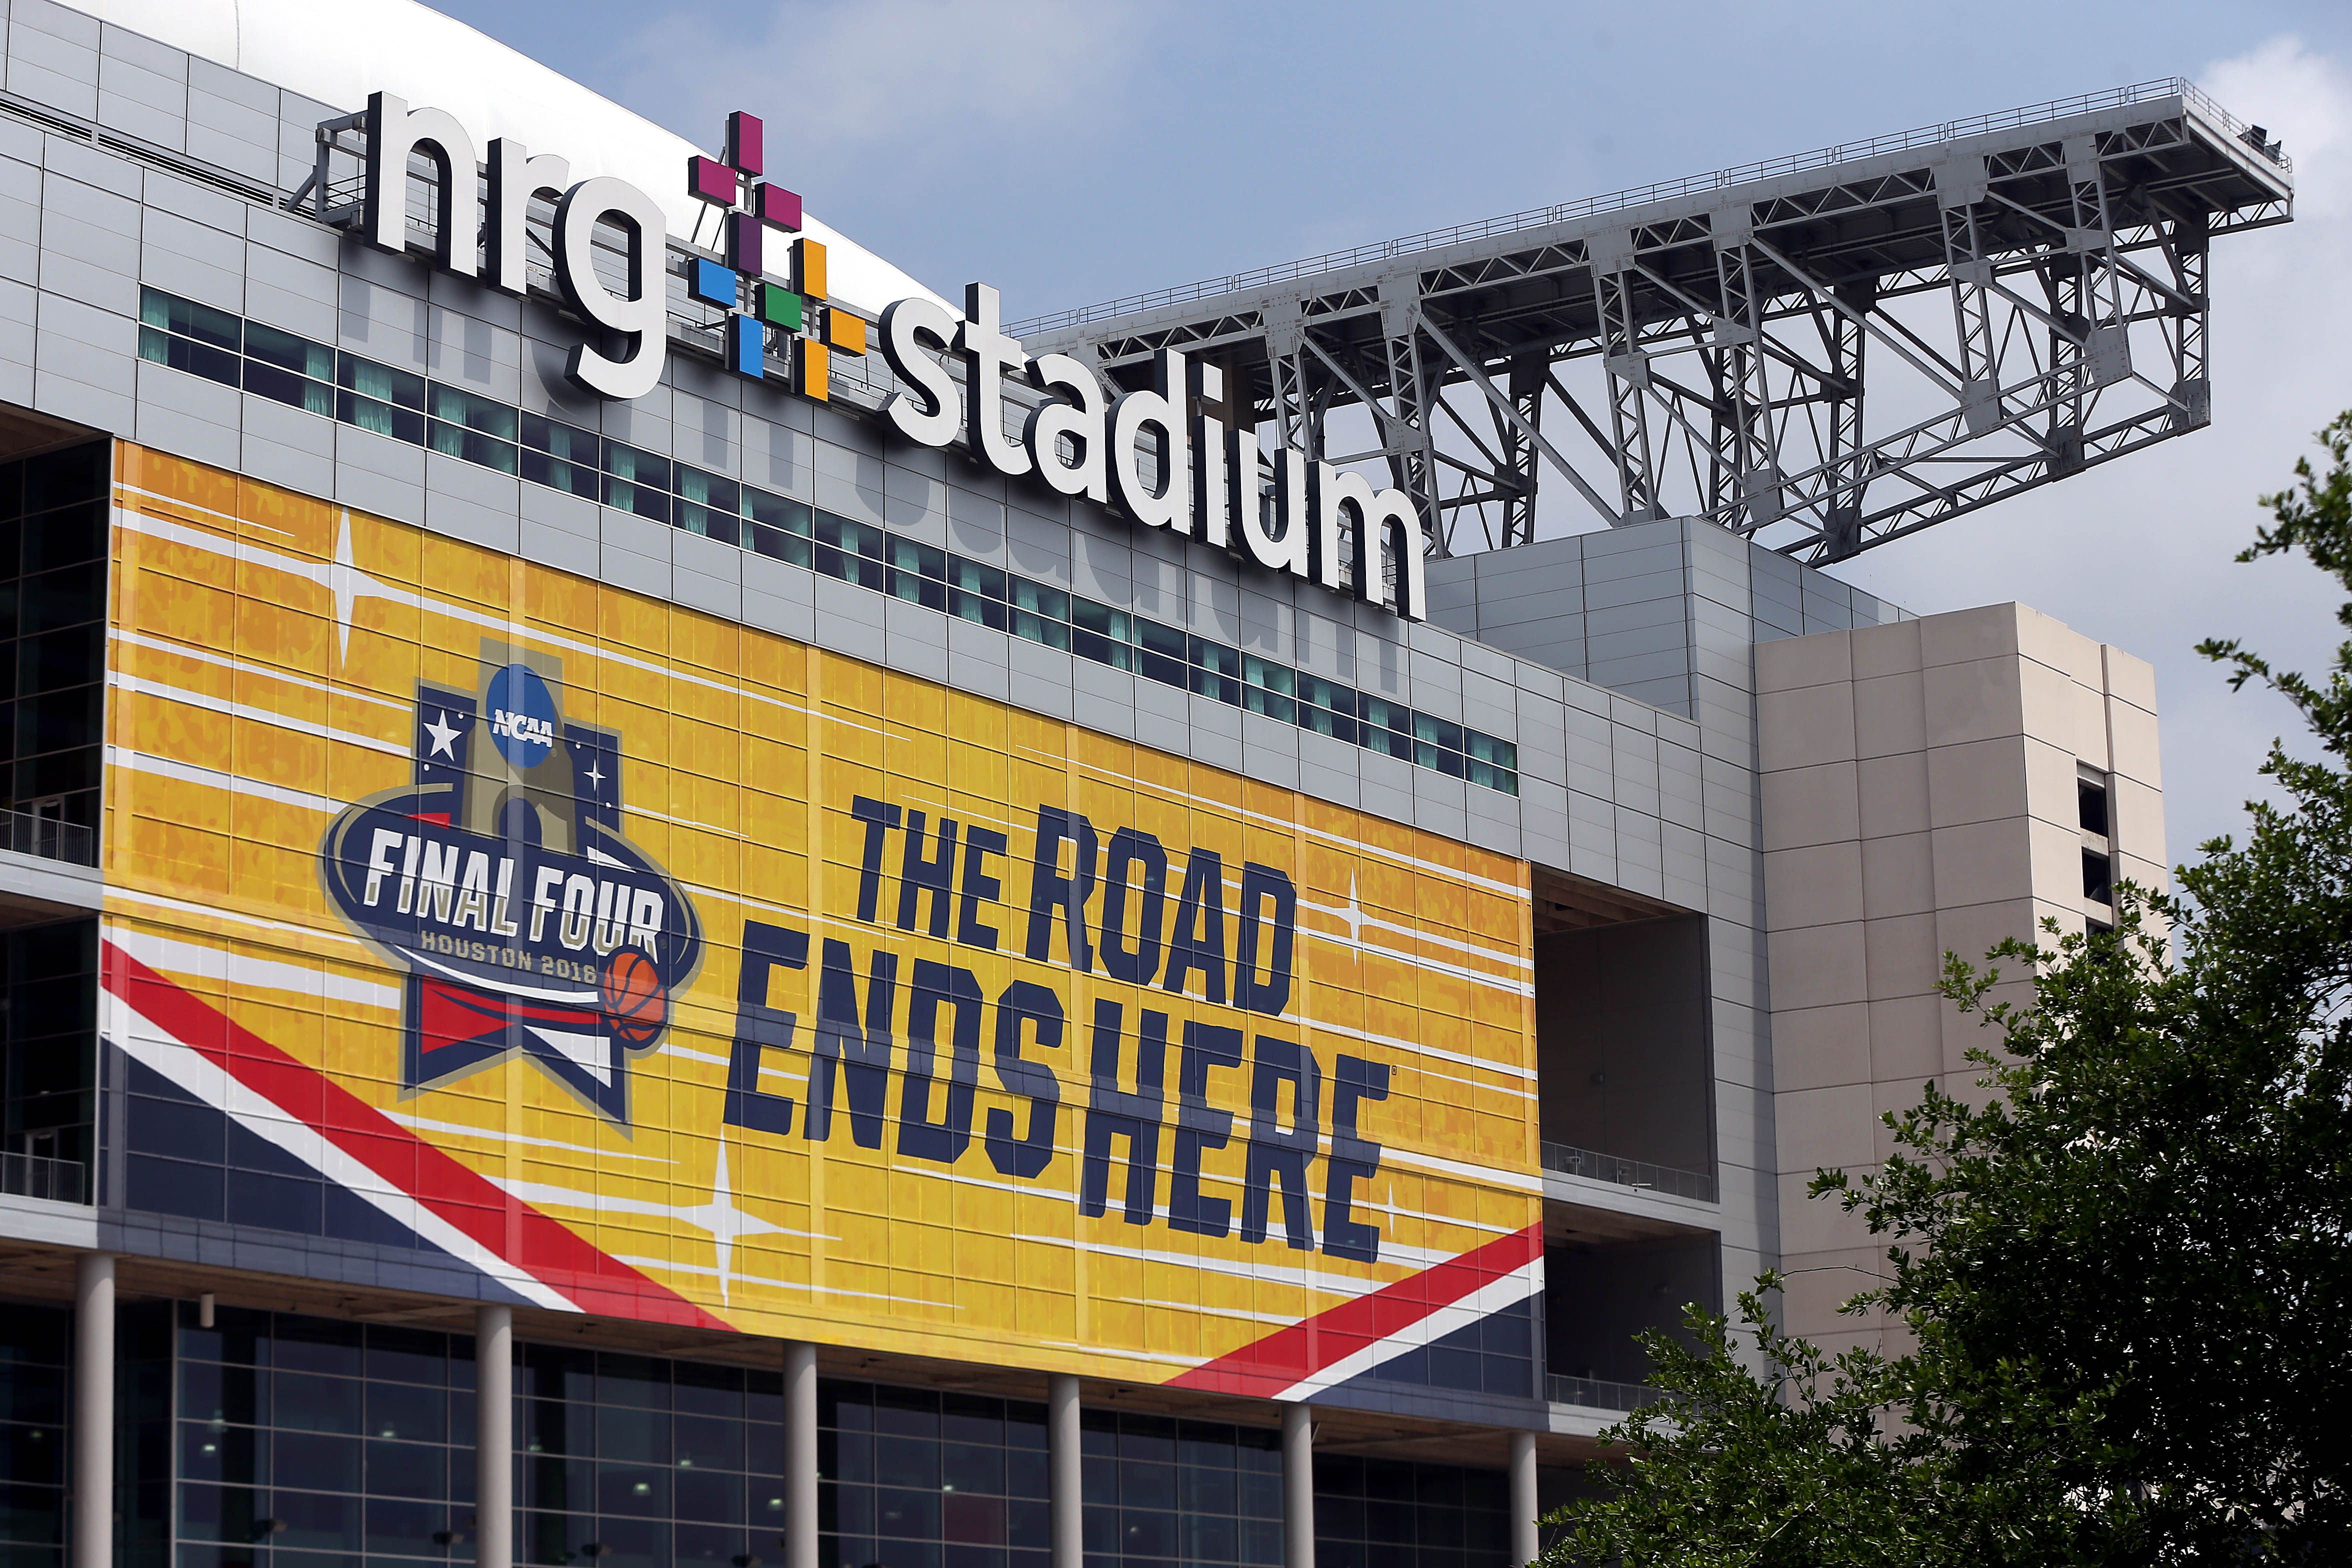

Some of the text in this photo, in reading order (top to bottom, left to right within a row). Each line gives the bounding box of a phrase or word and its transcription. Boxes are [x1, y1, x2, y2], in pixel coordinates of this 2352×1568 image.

[365, 91, 1426, 622] nrg stadium
[493, 708, 553, 748] NCAA
[363, 828, 664, 964] FINAL FOUR
[421, 930, 597, 984] HOUSTON 2016
[851, 794, 1297, 1018] THE ROAD
[722, 918, 1390, 1264] ENDS HERE
